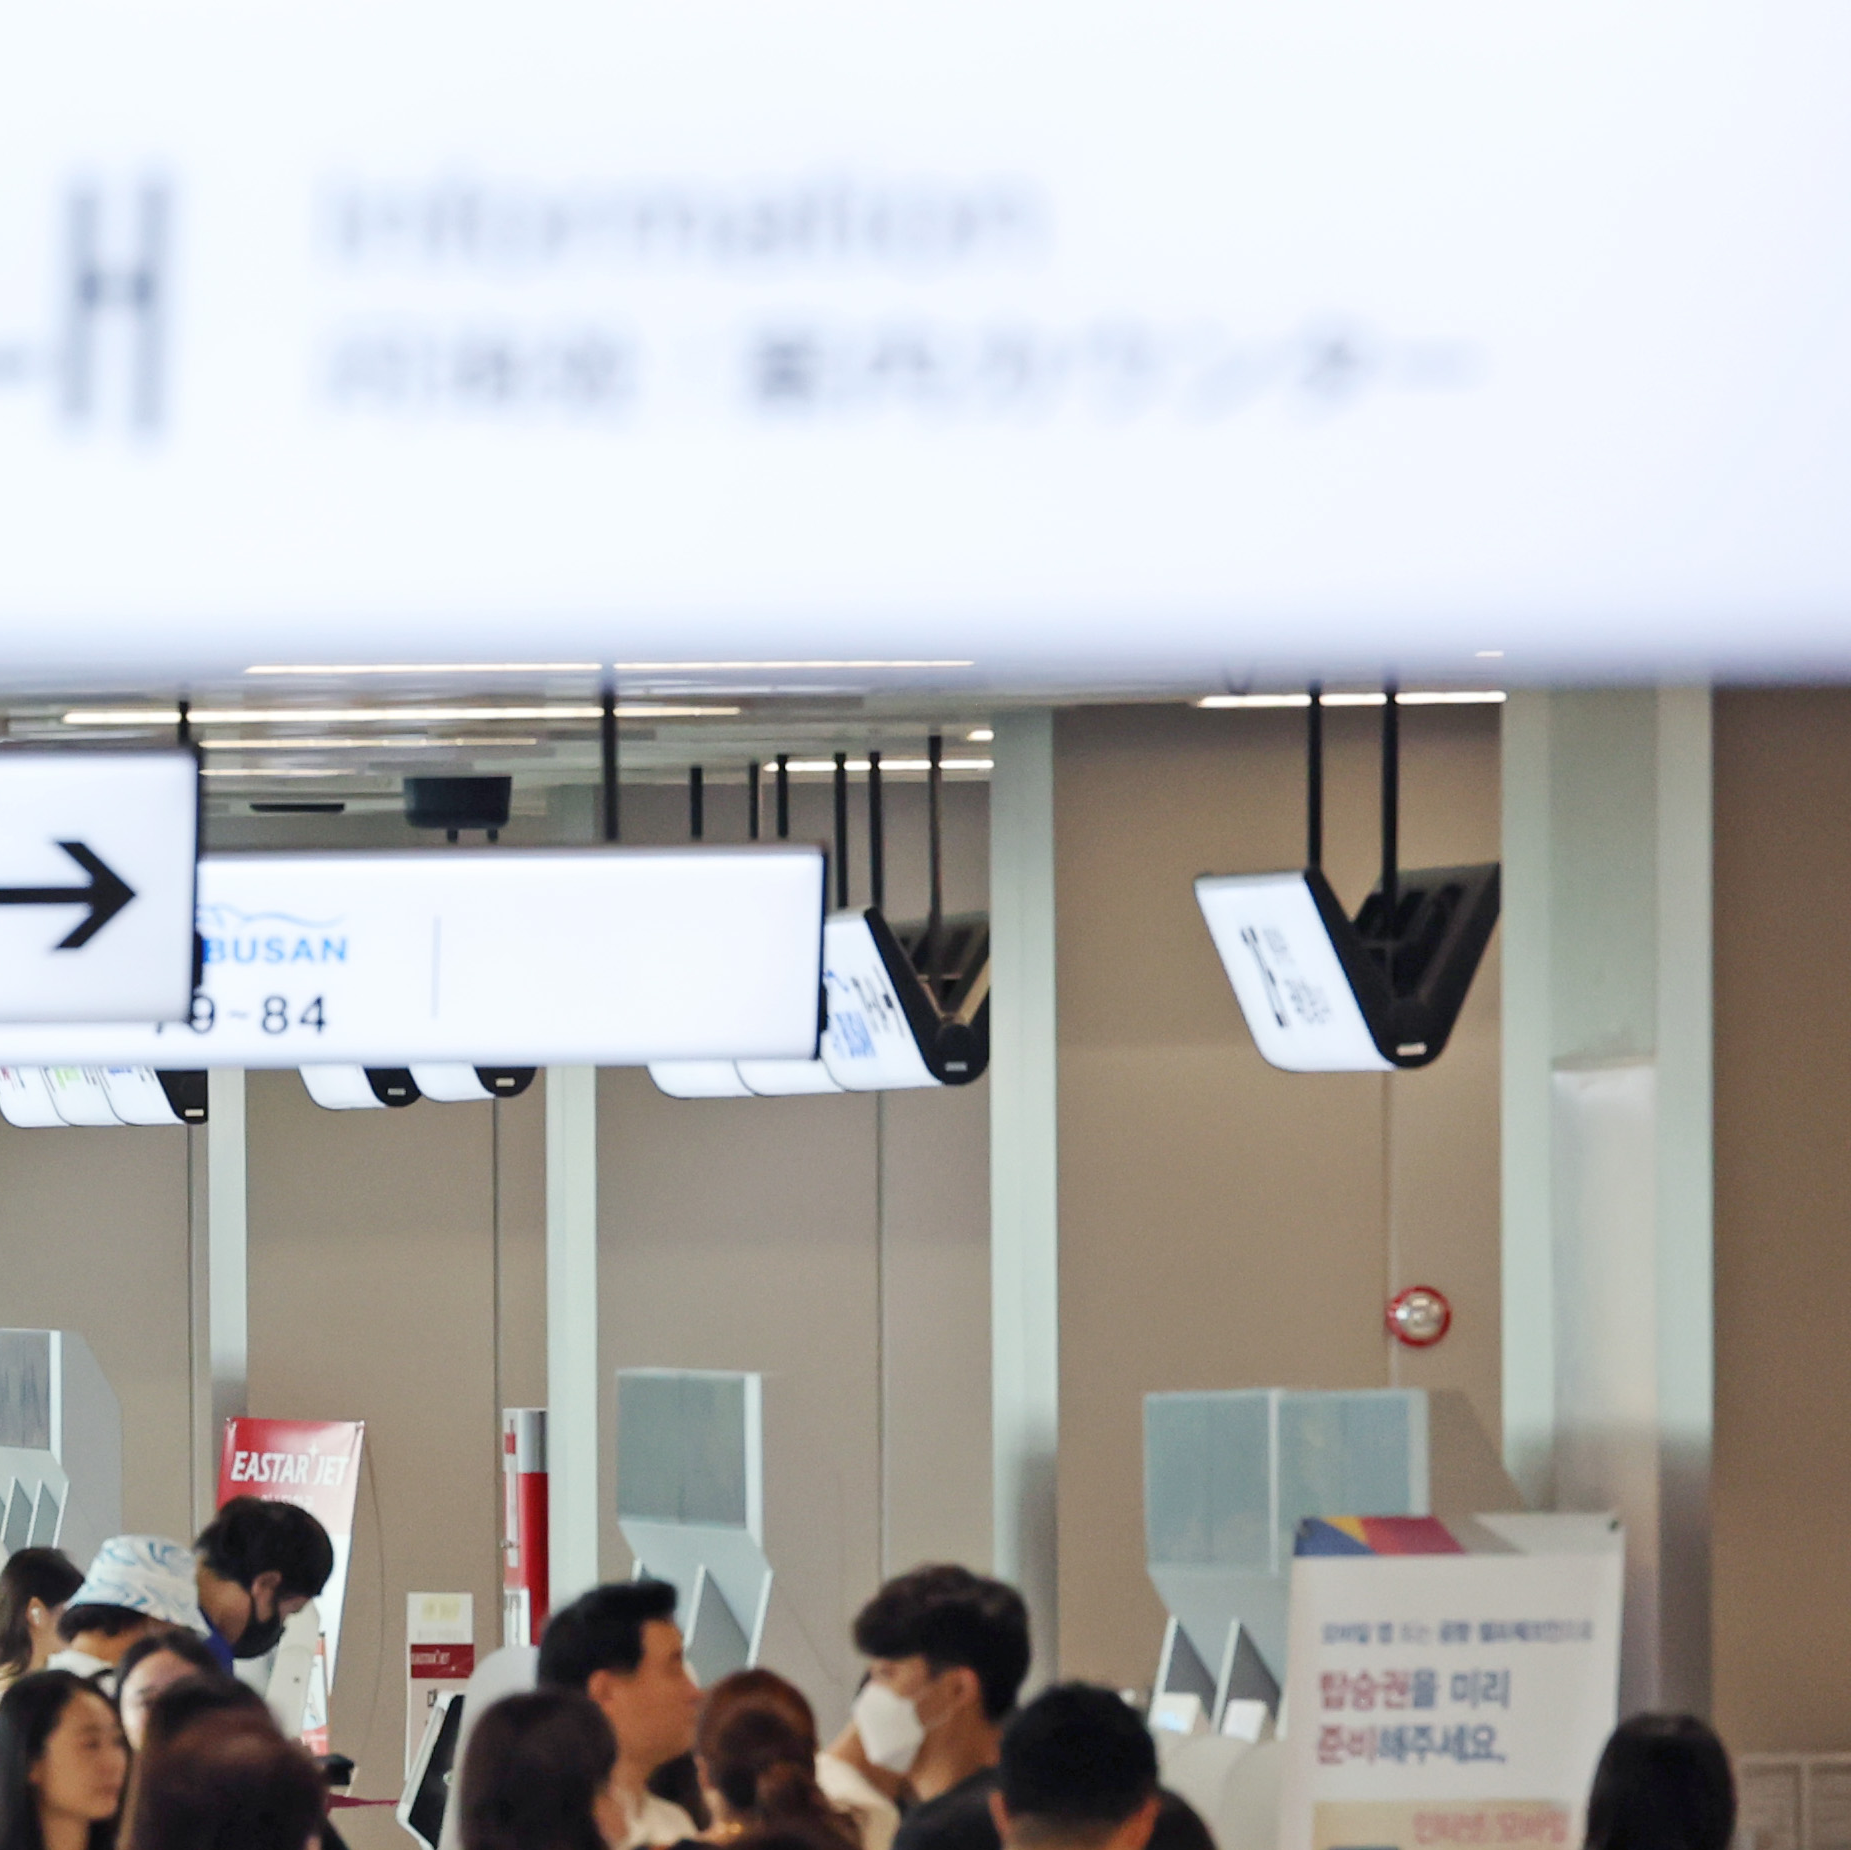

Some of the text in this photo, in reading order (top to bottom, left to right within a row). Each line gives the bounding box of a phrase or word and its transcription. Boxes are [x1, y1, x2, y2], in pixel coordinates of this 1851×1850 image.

[202, 936, 347, 965] BUSAN
[230, 1450, 350, 1486] EASTAR JET
[1320, 1668, 1510, 1710] 탑승권을 미리
